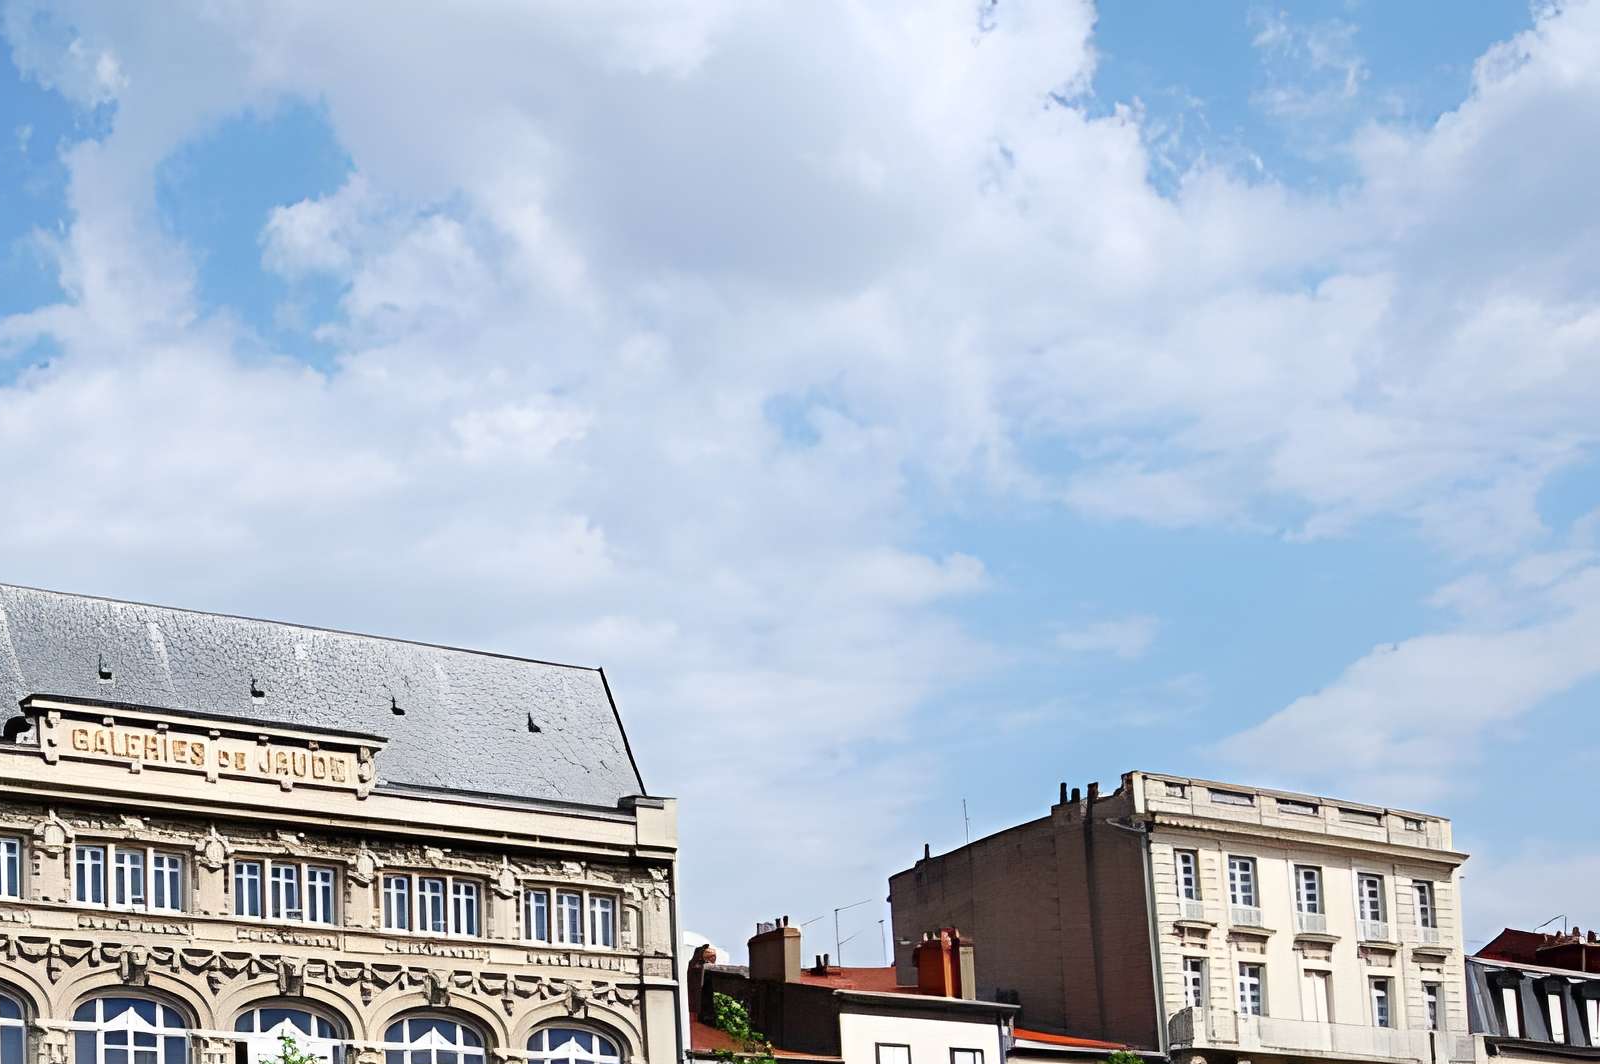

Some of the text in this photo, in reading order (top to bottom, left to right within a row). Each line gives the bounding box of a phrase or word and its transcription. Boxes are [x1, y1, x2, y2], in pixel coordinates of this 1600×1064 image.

[72, 728, 346, 783] GALERIES DE JAUDE
